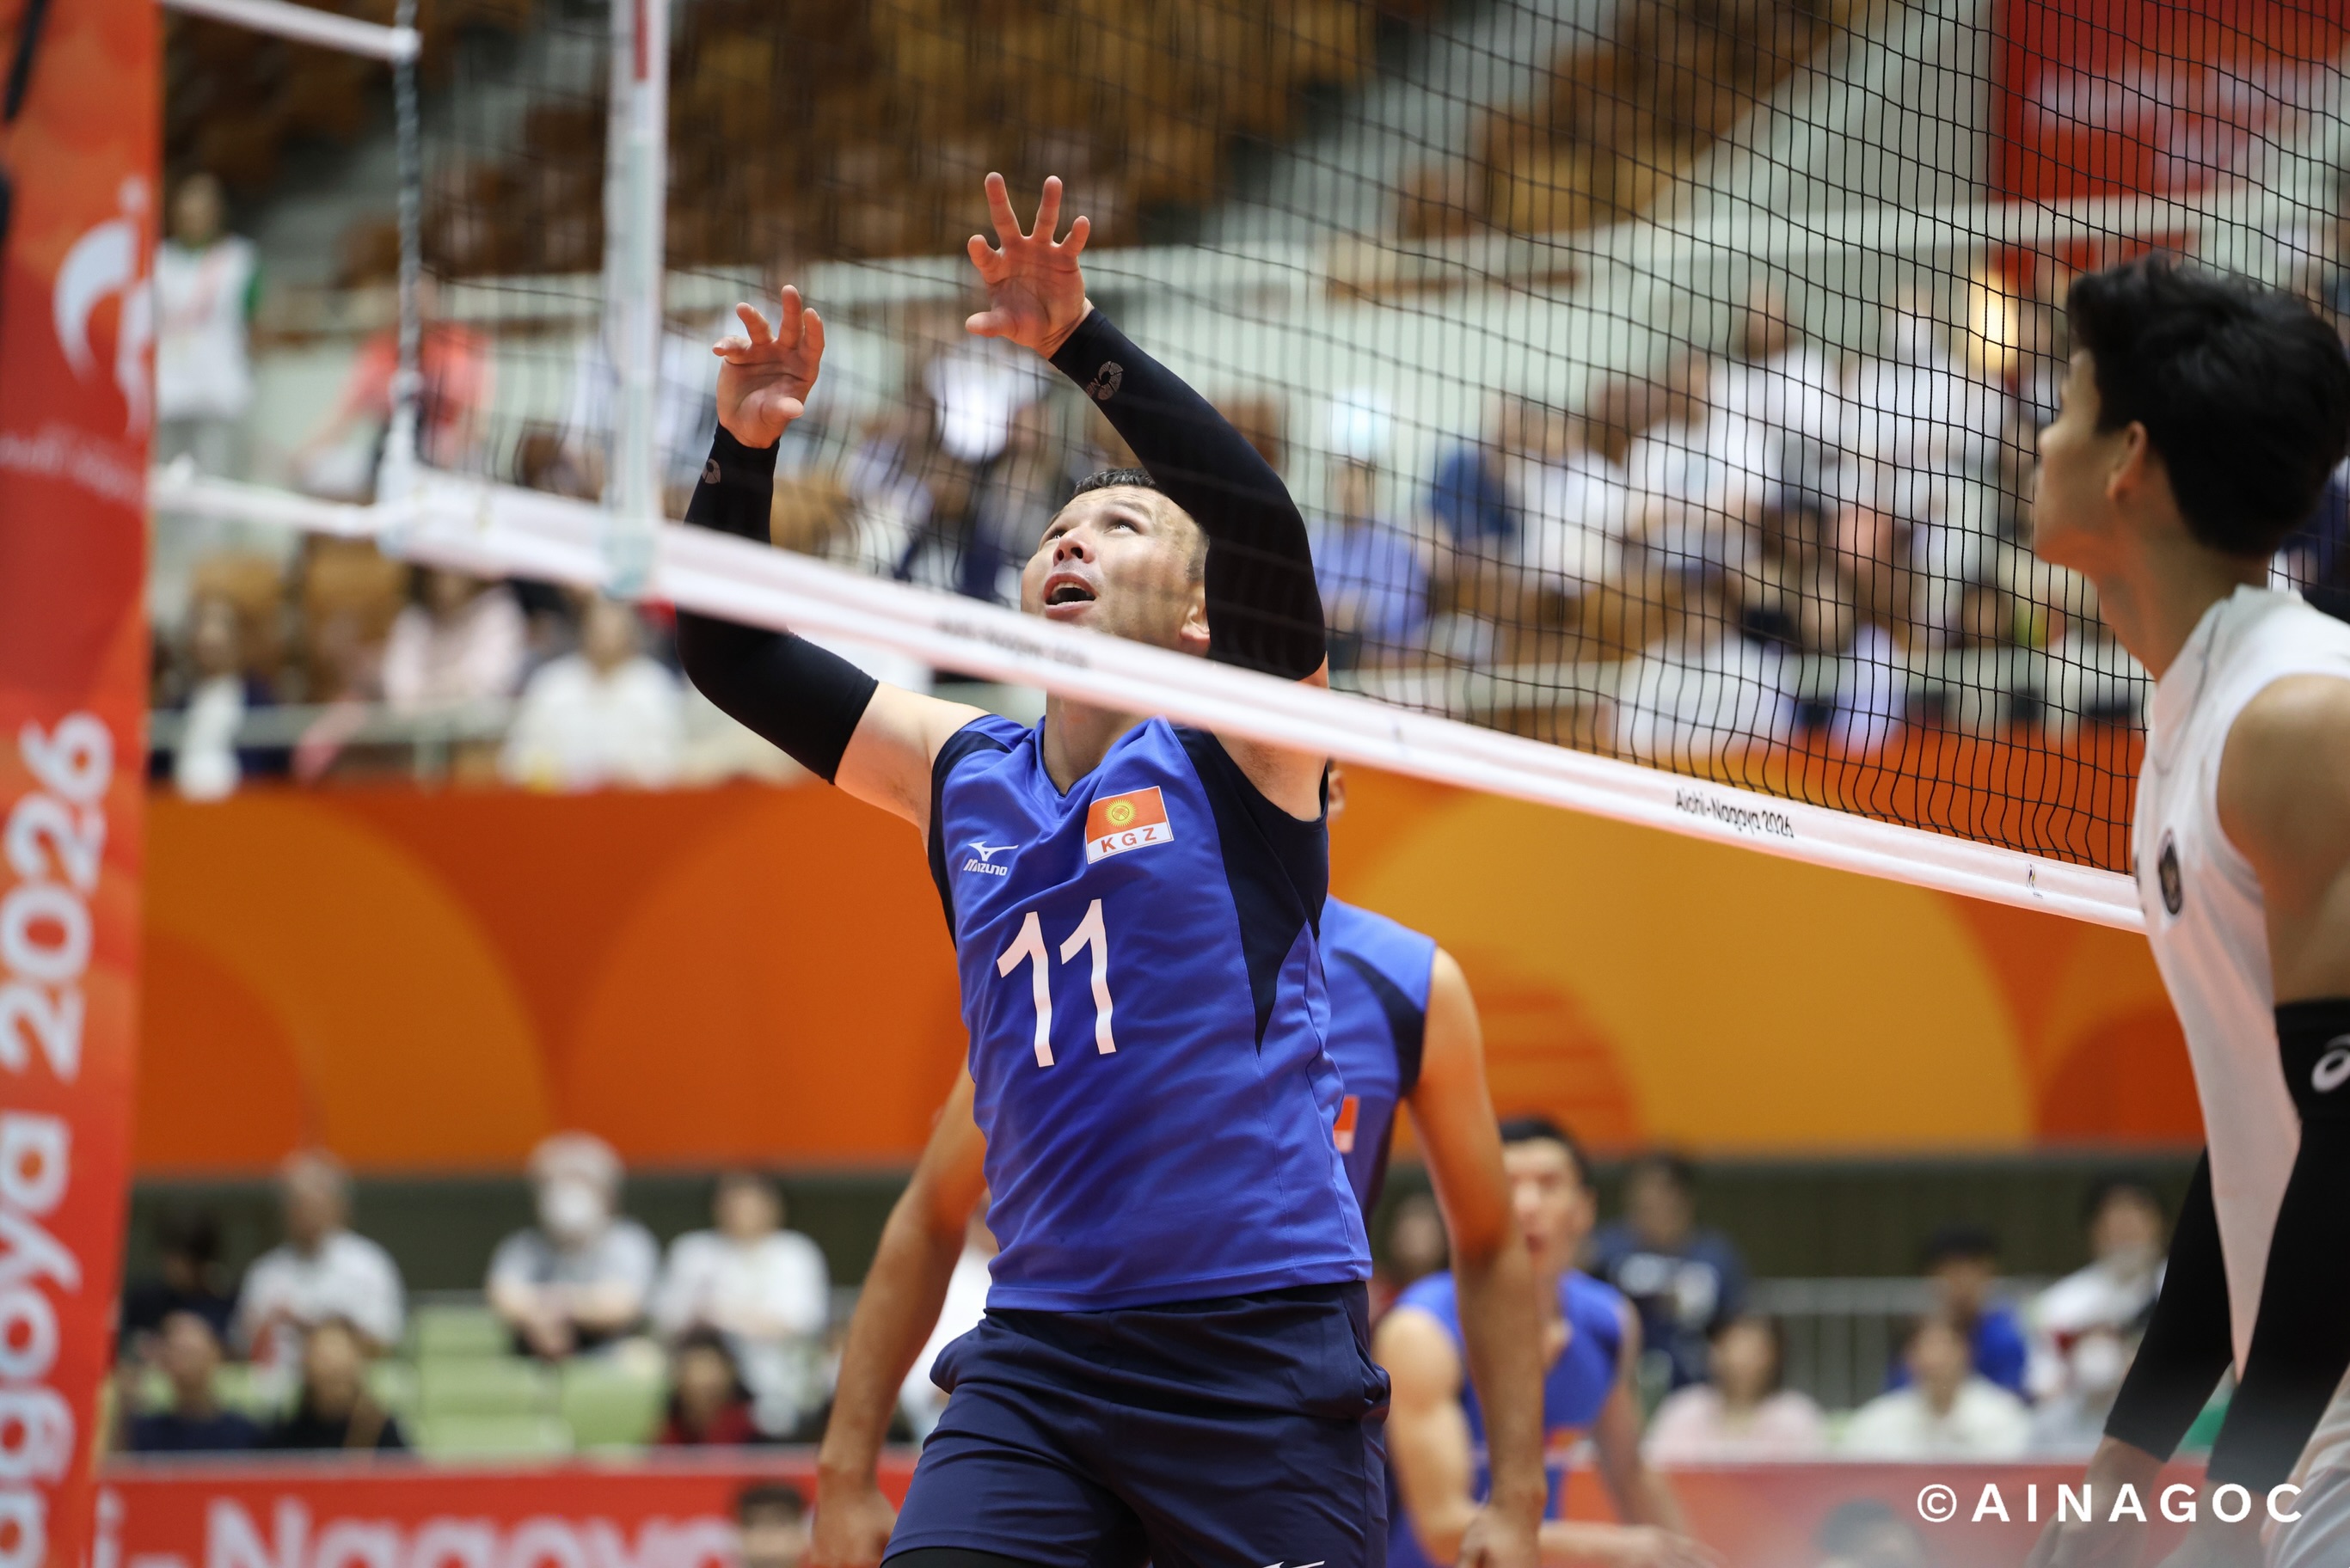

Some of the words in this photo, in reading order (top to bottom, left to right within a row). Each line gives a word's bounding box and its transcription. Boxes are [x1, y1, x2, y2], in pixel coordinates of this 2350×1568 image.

[1101, 827, 1157, 854] KGZ
[1762, 810, 1795, 839] 2026
[0, 710, 115, 1086] 2026
[997, 898, 1117, 1068] 11
